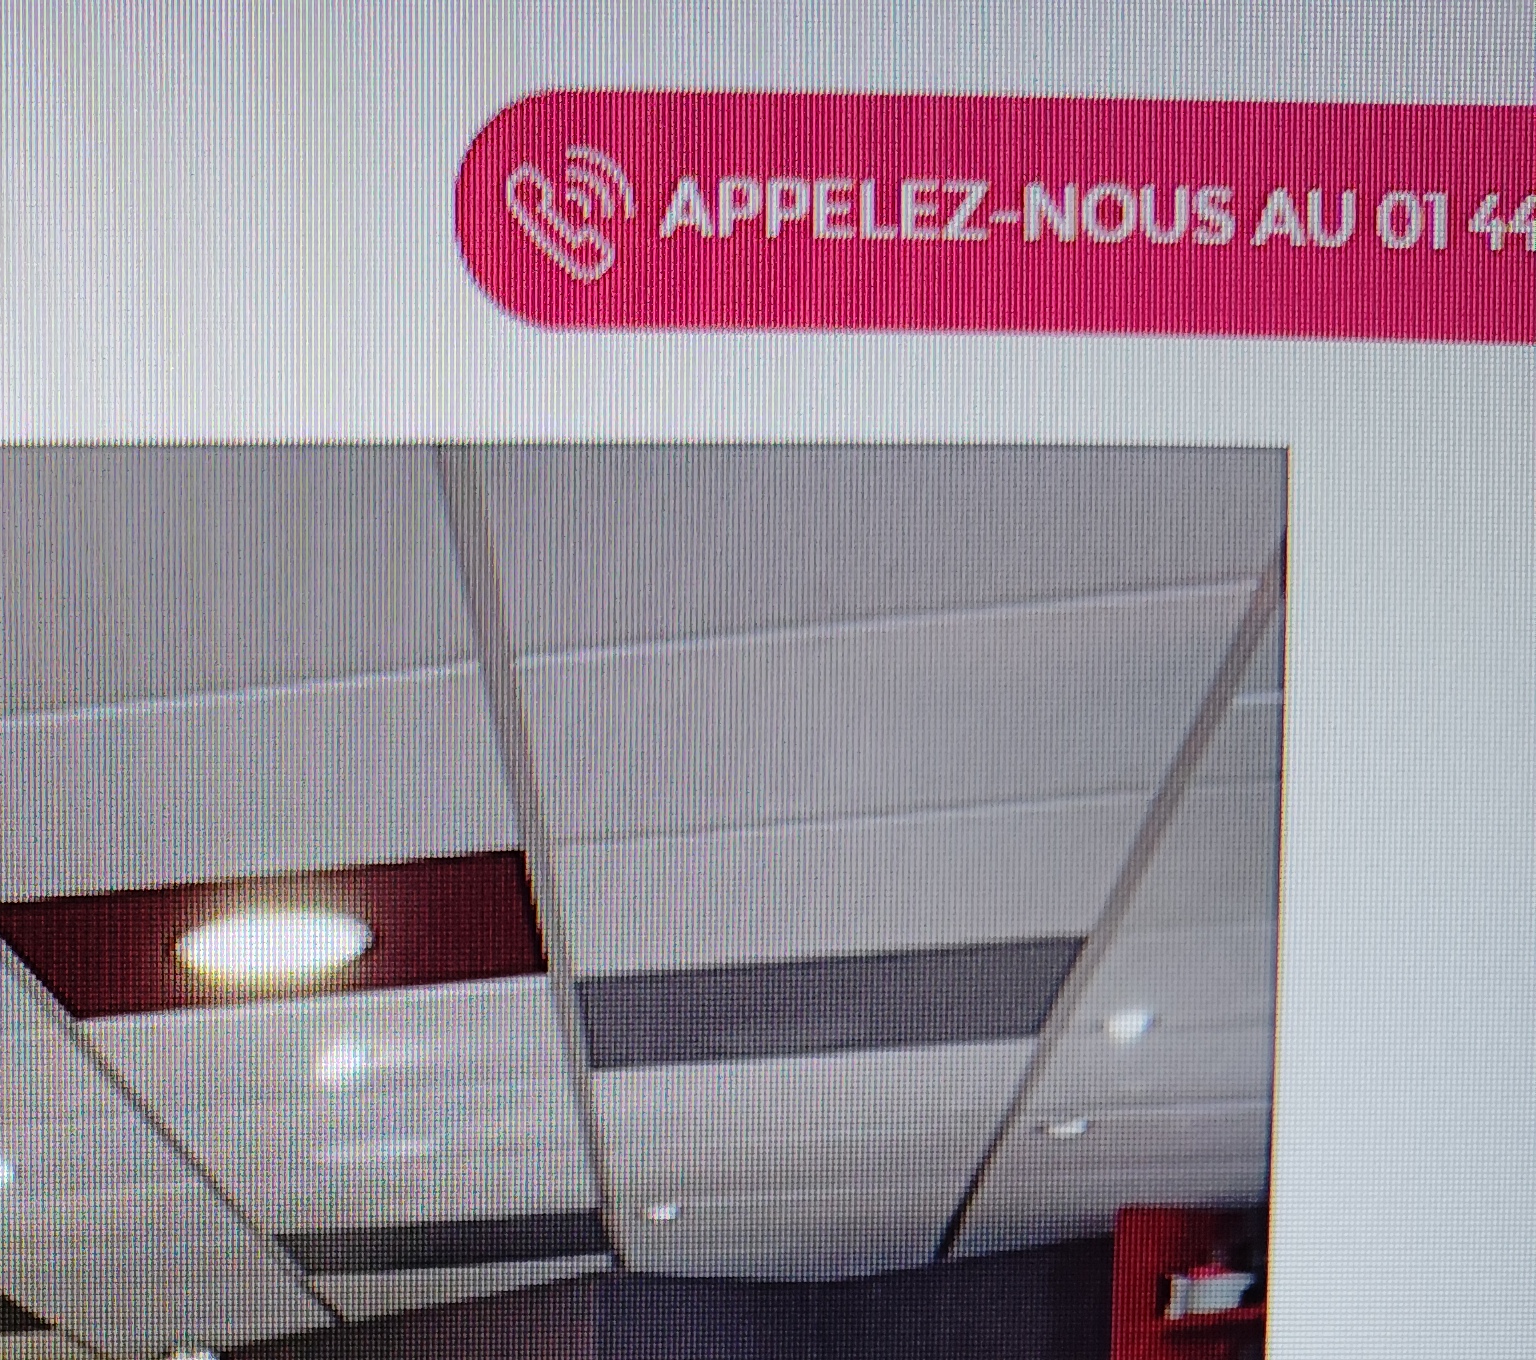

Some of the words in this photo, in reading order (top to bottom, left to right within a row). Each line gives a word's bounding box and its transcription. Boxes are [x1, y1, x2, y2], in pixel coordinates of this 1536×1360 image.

[660, 175, 1236, 245] APPELEZ-NOUS
[1250, 187, 1356, 248] AU
[1376, 190, 1448, 250] 01
